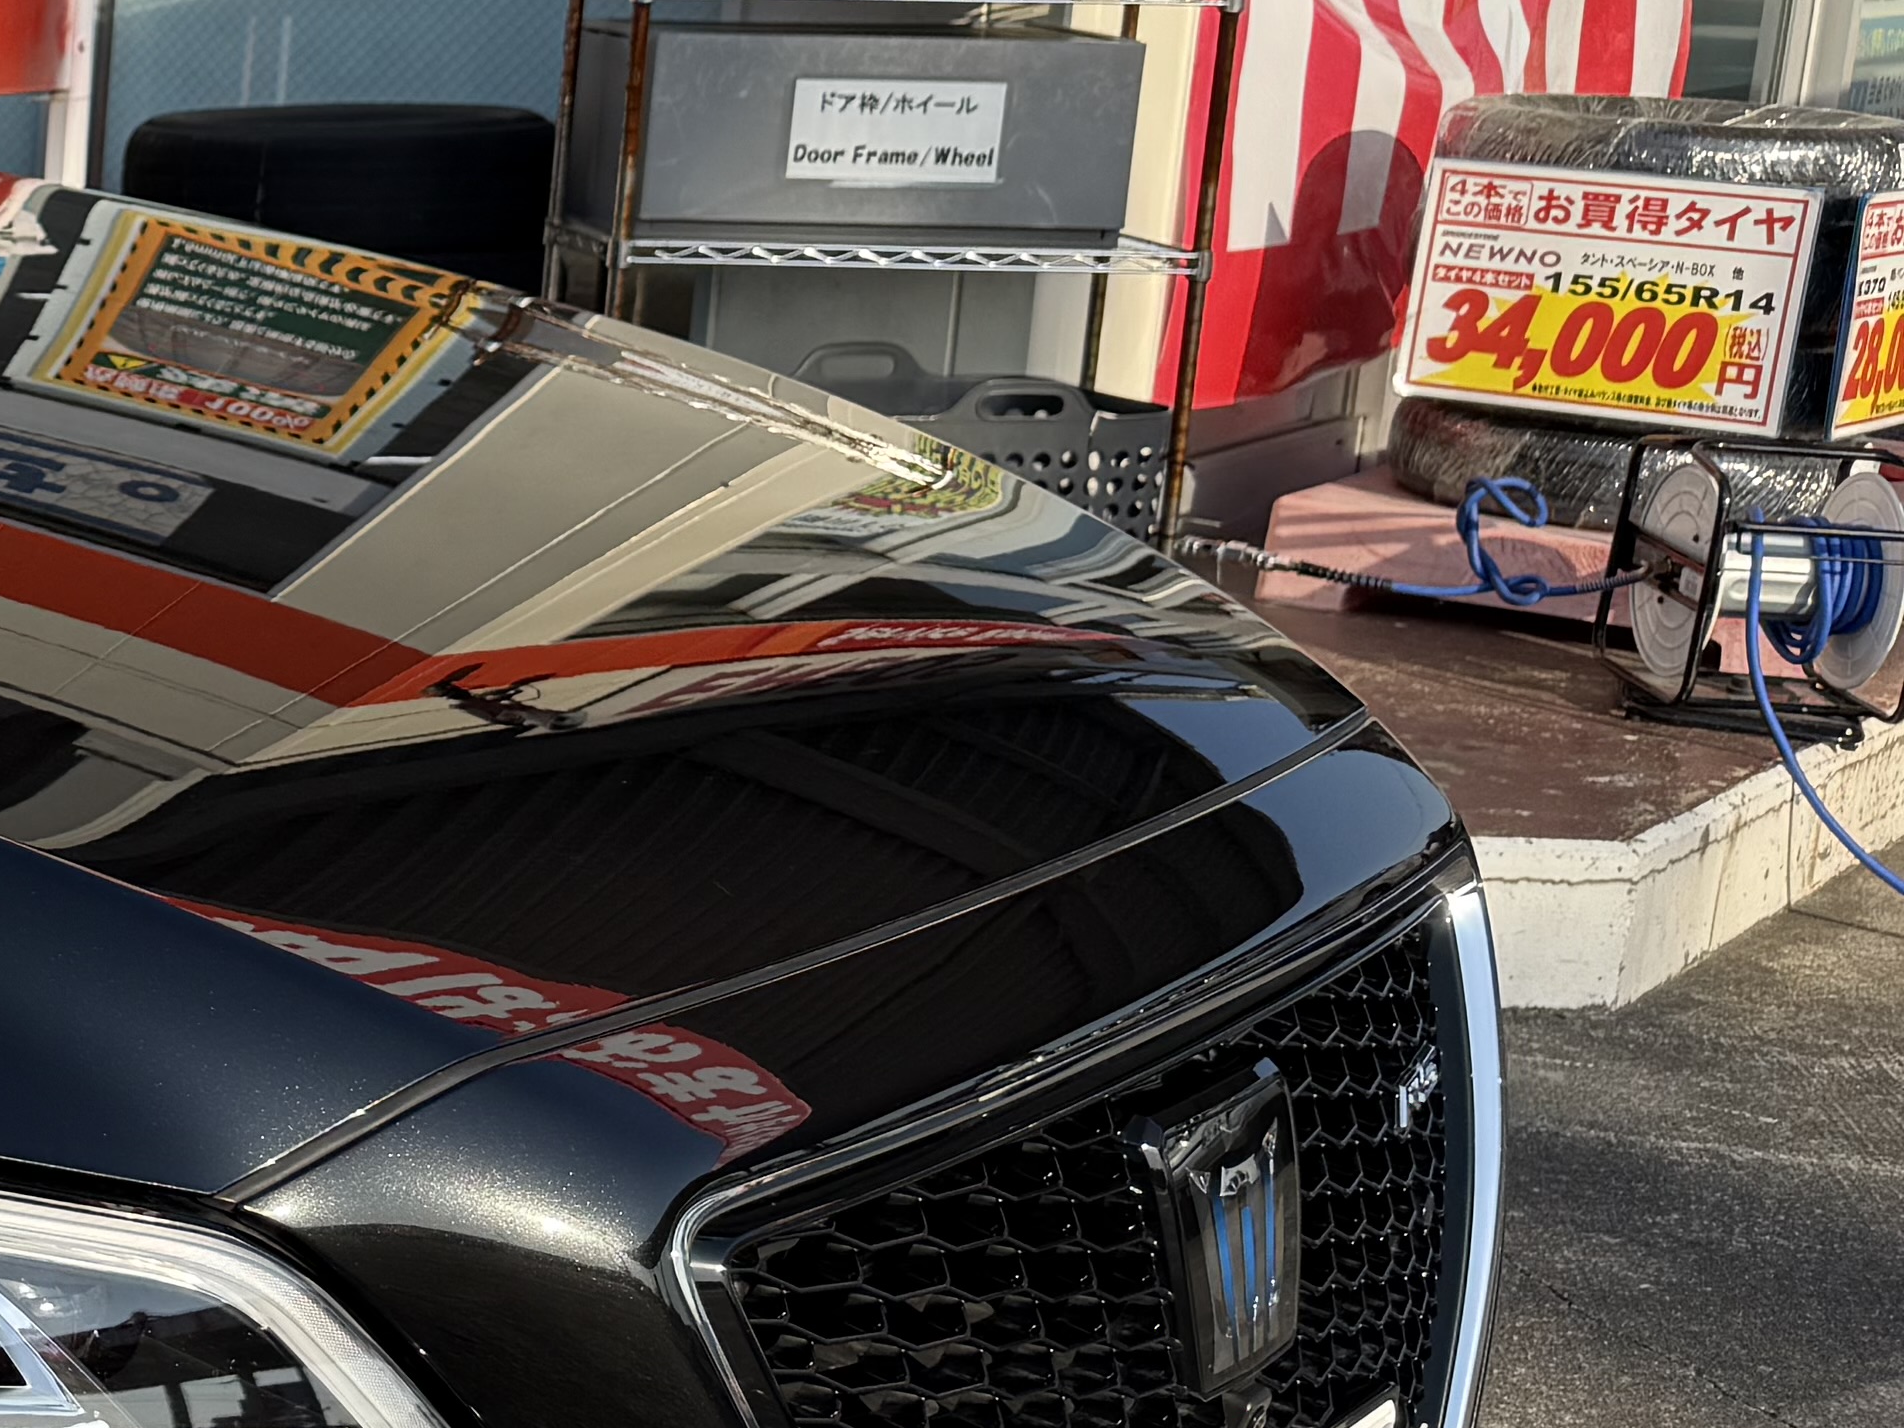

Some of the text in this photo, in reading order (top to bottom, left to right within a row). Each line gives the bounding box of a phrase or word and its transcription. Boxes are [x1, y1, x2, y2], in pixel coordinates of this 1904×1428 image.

[819, 92, 978, 116] ドア枠/ホイール
[792, 145, 845, 166] Door
[1449, 179, 1527, 203] 4本で
[1446, 199, 1523, 224] この価格
[1533, 187, 1796, 246] お買得タイヤ
[1440, 241, 1562, 267] NEWNO
[1433, 267, 1531, 289] タイヤ4本セット
[1731, 266, 1745, 281] 他
[1543, 271, 1776, 316] 155/65R14
[1427, 288, 1718, 391] 34,000
[1724, 323, 1769, 362] (税込)
[1714, 362, 1764, 400] 円
